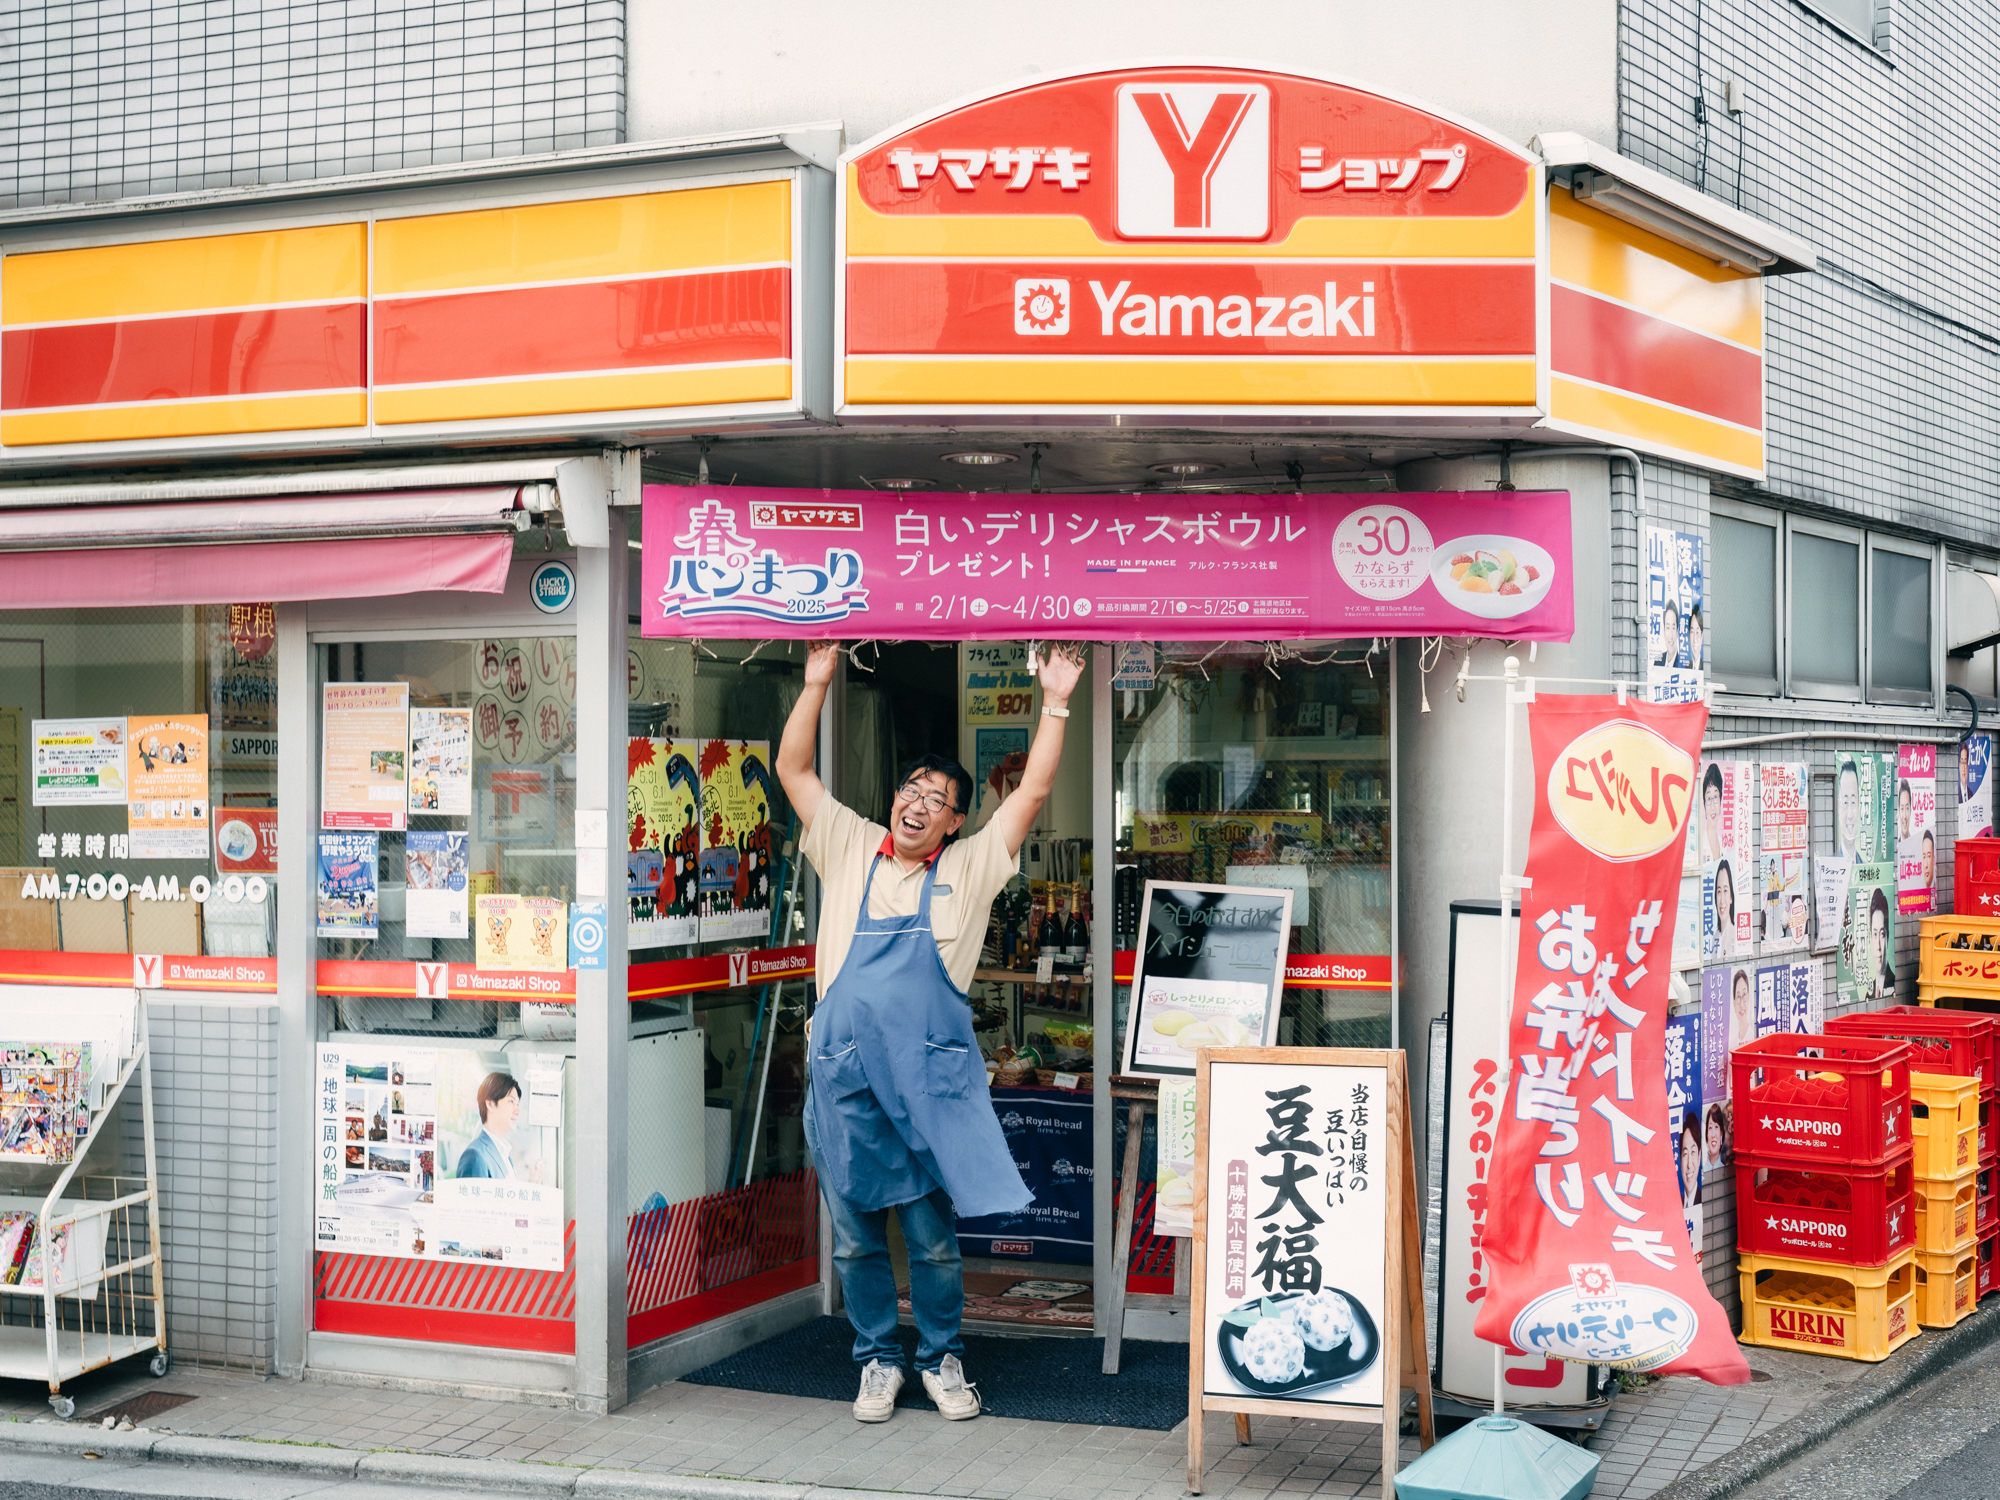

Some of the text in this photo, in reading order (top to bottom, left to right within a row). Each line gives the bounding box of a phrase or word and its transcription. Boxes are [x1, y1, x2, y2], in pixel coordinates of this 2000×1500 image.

[890, 147, 1091, 192] ヤマザキ
[1132, 92, 1258, 229] Y
[1300, 142, 1470, 191] ショップ
[1089, 281, 1376, 337] Yamazaki
[781, 508, 856, 525] ヤマザキ
[895, 508, 1306, 547] 白いデリシャスボウル
[1357, 515, 1411, 557] 30
[668, 551, 862, 597] パンまつり
[1188, 561, 1278, 570] アルク・フランス社製
[1354, 560, 1414, 575] かならず
[539, 577, 566, 588] LUCKY
[1677, 537, 1693, 617] 落合
[539, 586, 567, 597] STRIKE
[786, 598, 827, 615] 2025
[1097, 603, 1147, 612] 景品引換期間
[968, 649, 1001, 662] プライス
[1909, 747, 1931, 774] れいわ
[639, 770, 657, 784] 5.31
[716, 770, 733, 784] 5.31
[1761, 765, 1797, 788] 物価高から
[652, 785, 664, 798] 6.1
[728, 785, 739, 798] 6.1
[1762, 787, 1800, 809] くらしまもる
[1911, 791, 1935, 811] じんむら
[658, 814, 673, 822] 2025
[732, 812, 747, 821] 2025
[1743, 766, 1751, 863] 困っている人を
[1966, 805, 1985, 823] 公明党
[37, 832, 129, 859] 営業時間
[1899, 859, 1923, 881] 山本太郎
[1156, 902, 1273, 927] 今日のおすすめ
[1703, 876, 1715, 938] 吉良
[1739, 913, 1749, 927] 日本
[138, 957, 266, 985] Y Yamazaki Shop
[731, 954, 807, 984] Y Yamazaki Shop
[1332, 964, 1367, 981] Shop
[420, 964, 561, 996] Y Yamazaki Shop
[1170, 992, 1259, 1007] しっとりメロンパン
[1708, 974, 1717, 1080] じゃない社会へ
[1716, 973, 1726, 1089] ひとりでも孤独
[322, 1053, 339, 1064] U29
[1664, 1024, 1687, 1135] 落合
[1685, 1041, 1693, 1104] おちあい
[1025, 1115, 1083, 1130] Royal Bread
[1775, 1117, 1842, 1136] SAPPORO
[322, 1076, 338, 1201] 地球一周の船旅
[1348, 1082, 1370, 1192] 当店自慢の
[1775, 1137, 1812, 1147] サッポロビール
[1323, 1108, 1349, 1208] 豆いっぱい
[458, 1184, 542, 1202] 地球一周の船旅
[1250, 1084, 1326, 1296] 豆大福
[1023, 1206, 1080, 1219] Royal Bread
[1226, 1165, 1248, 1292] 十勝産小豆使用
[1781, 1218, 1847, 1238] SAPPORO
[1002, 1243, 1030, 1252] ヤマザキ
[1780, 1237, 1817, 1248] サッポロビール
[1770, 1308, 1845, 1339] KIRIN
[1794, 1333, 1822, 1344] キリンビール
